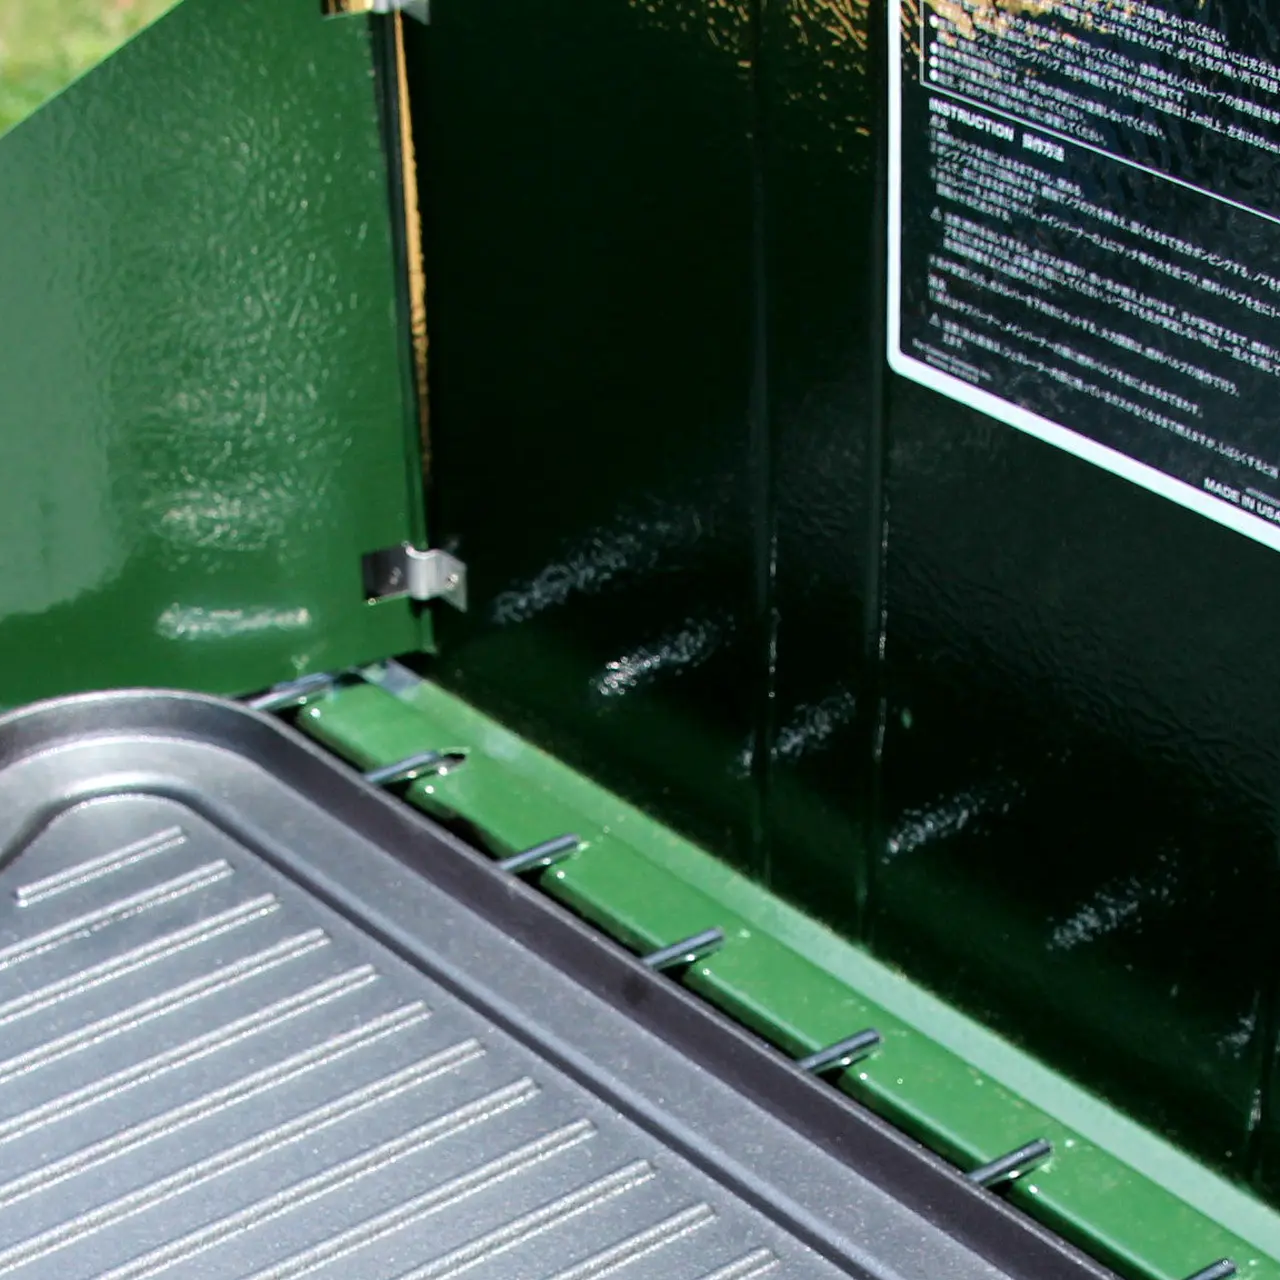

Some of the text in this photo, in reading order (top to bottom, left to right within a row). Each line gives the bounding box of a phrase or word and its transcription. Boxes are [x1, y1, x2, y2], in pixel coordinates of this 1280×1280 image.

[928, 95, 1014, 143] INSTRUCTION
[1203, 475, 1240, 505] MADE
[1241, 492, 1254, 512] IN
